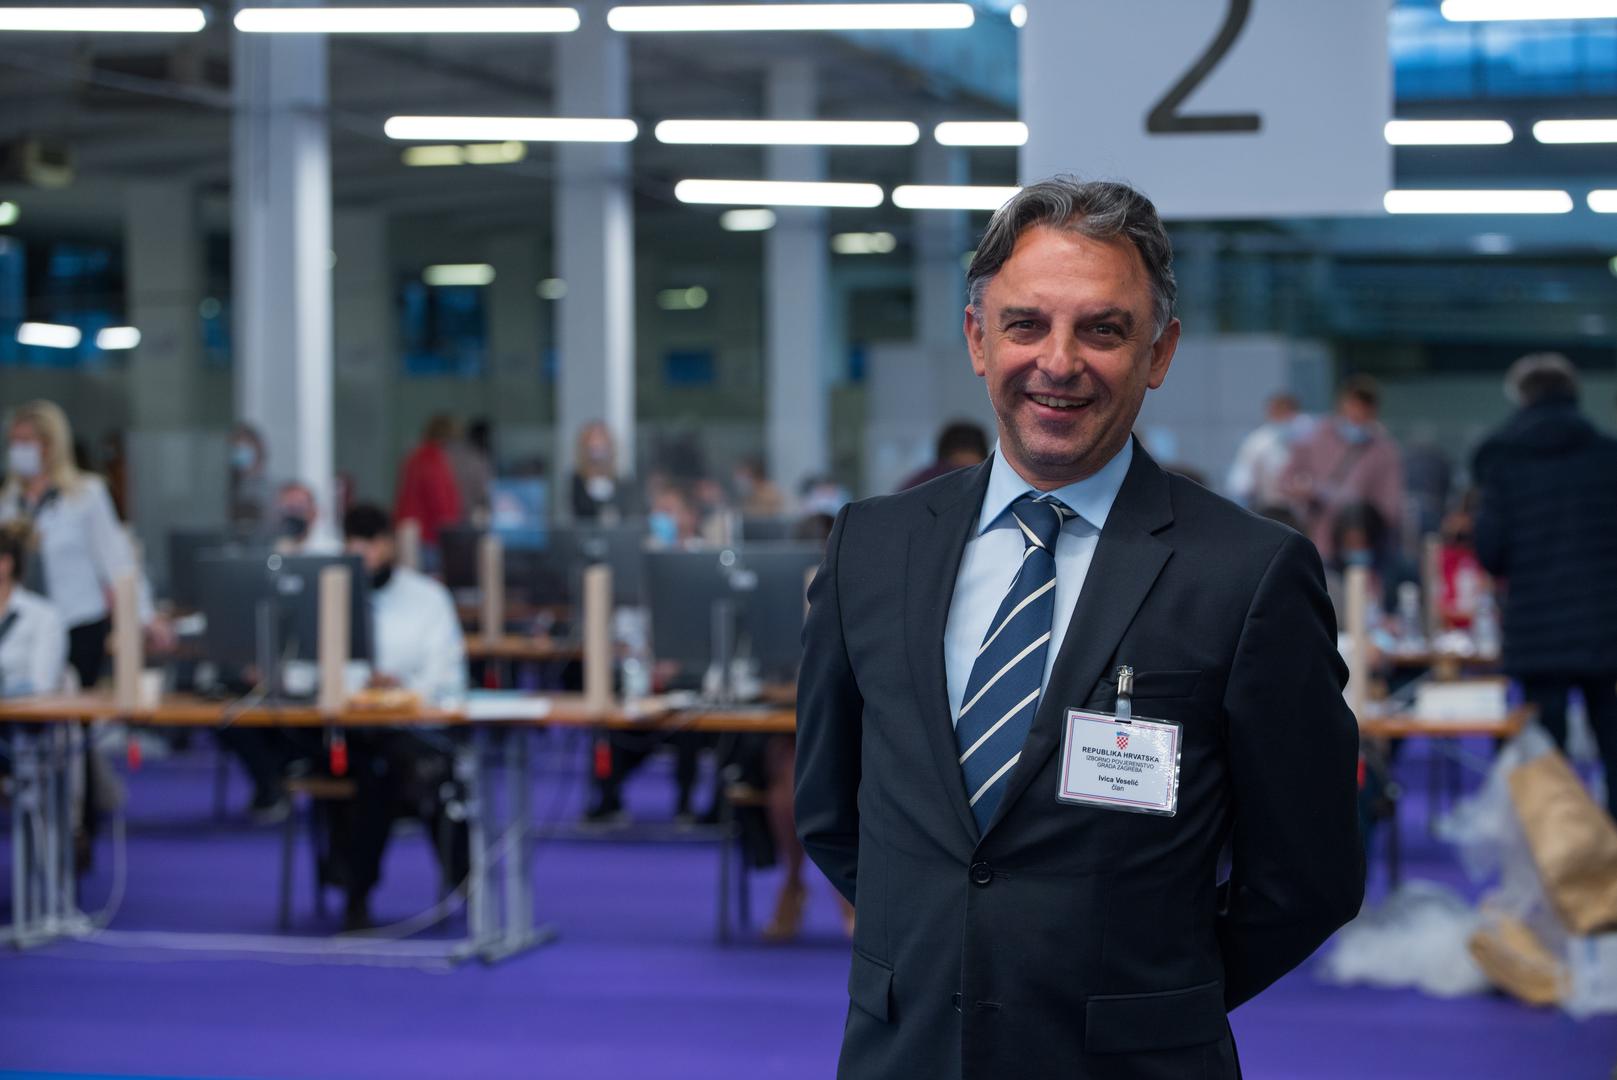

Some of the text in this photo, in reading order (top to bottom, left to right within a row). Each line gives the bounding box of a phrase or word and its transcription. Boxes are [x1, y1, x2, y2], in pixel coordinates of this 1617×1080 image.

[1146, 0, 1262, 134] 2
[1082, 746, 1159, 763] REPUBLIKA HRVATSKA
[1086, 755, 1155, 770] IZBORNO POVJERENSTVO
[1116, 765, 1143, 773] ZAGREBA
[1098, 775, 1139, 786] Ivica Veselić
[1111, 784, 1124, 792] član
